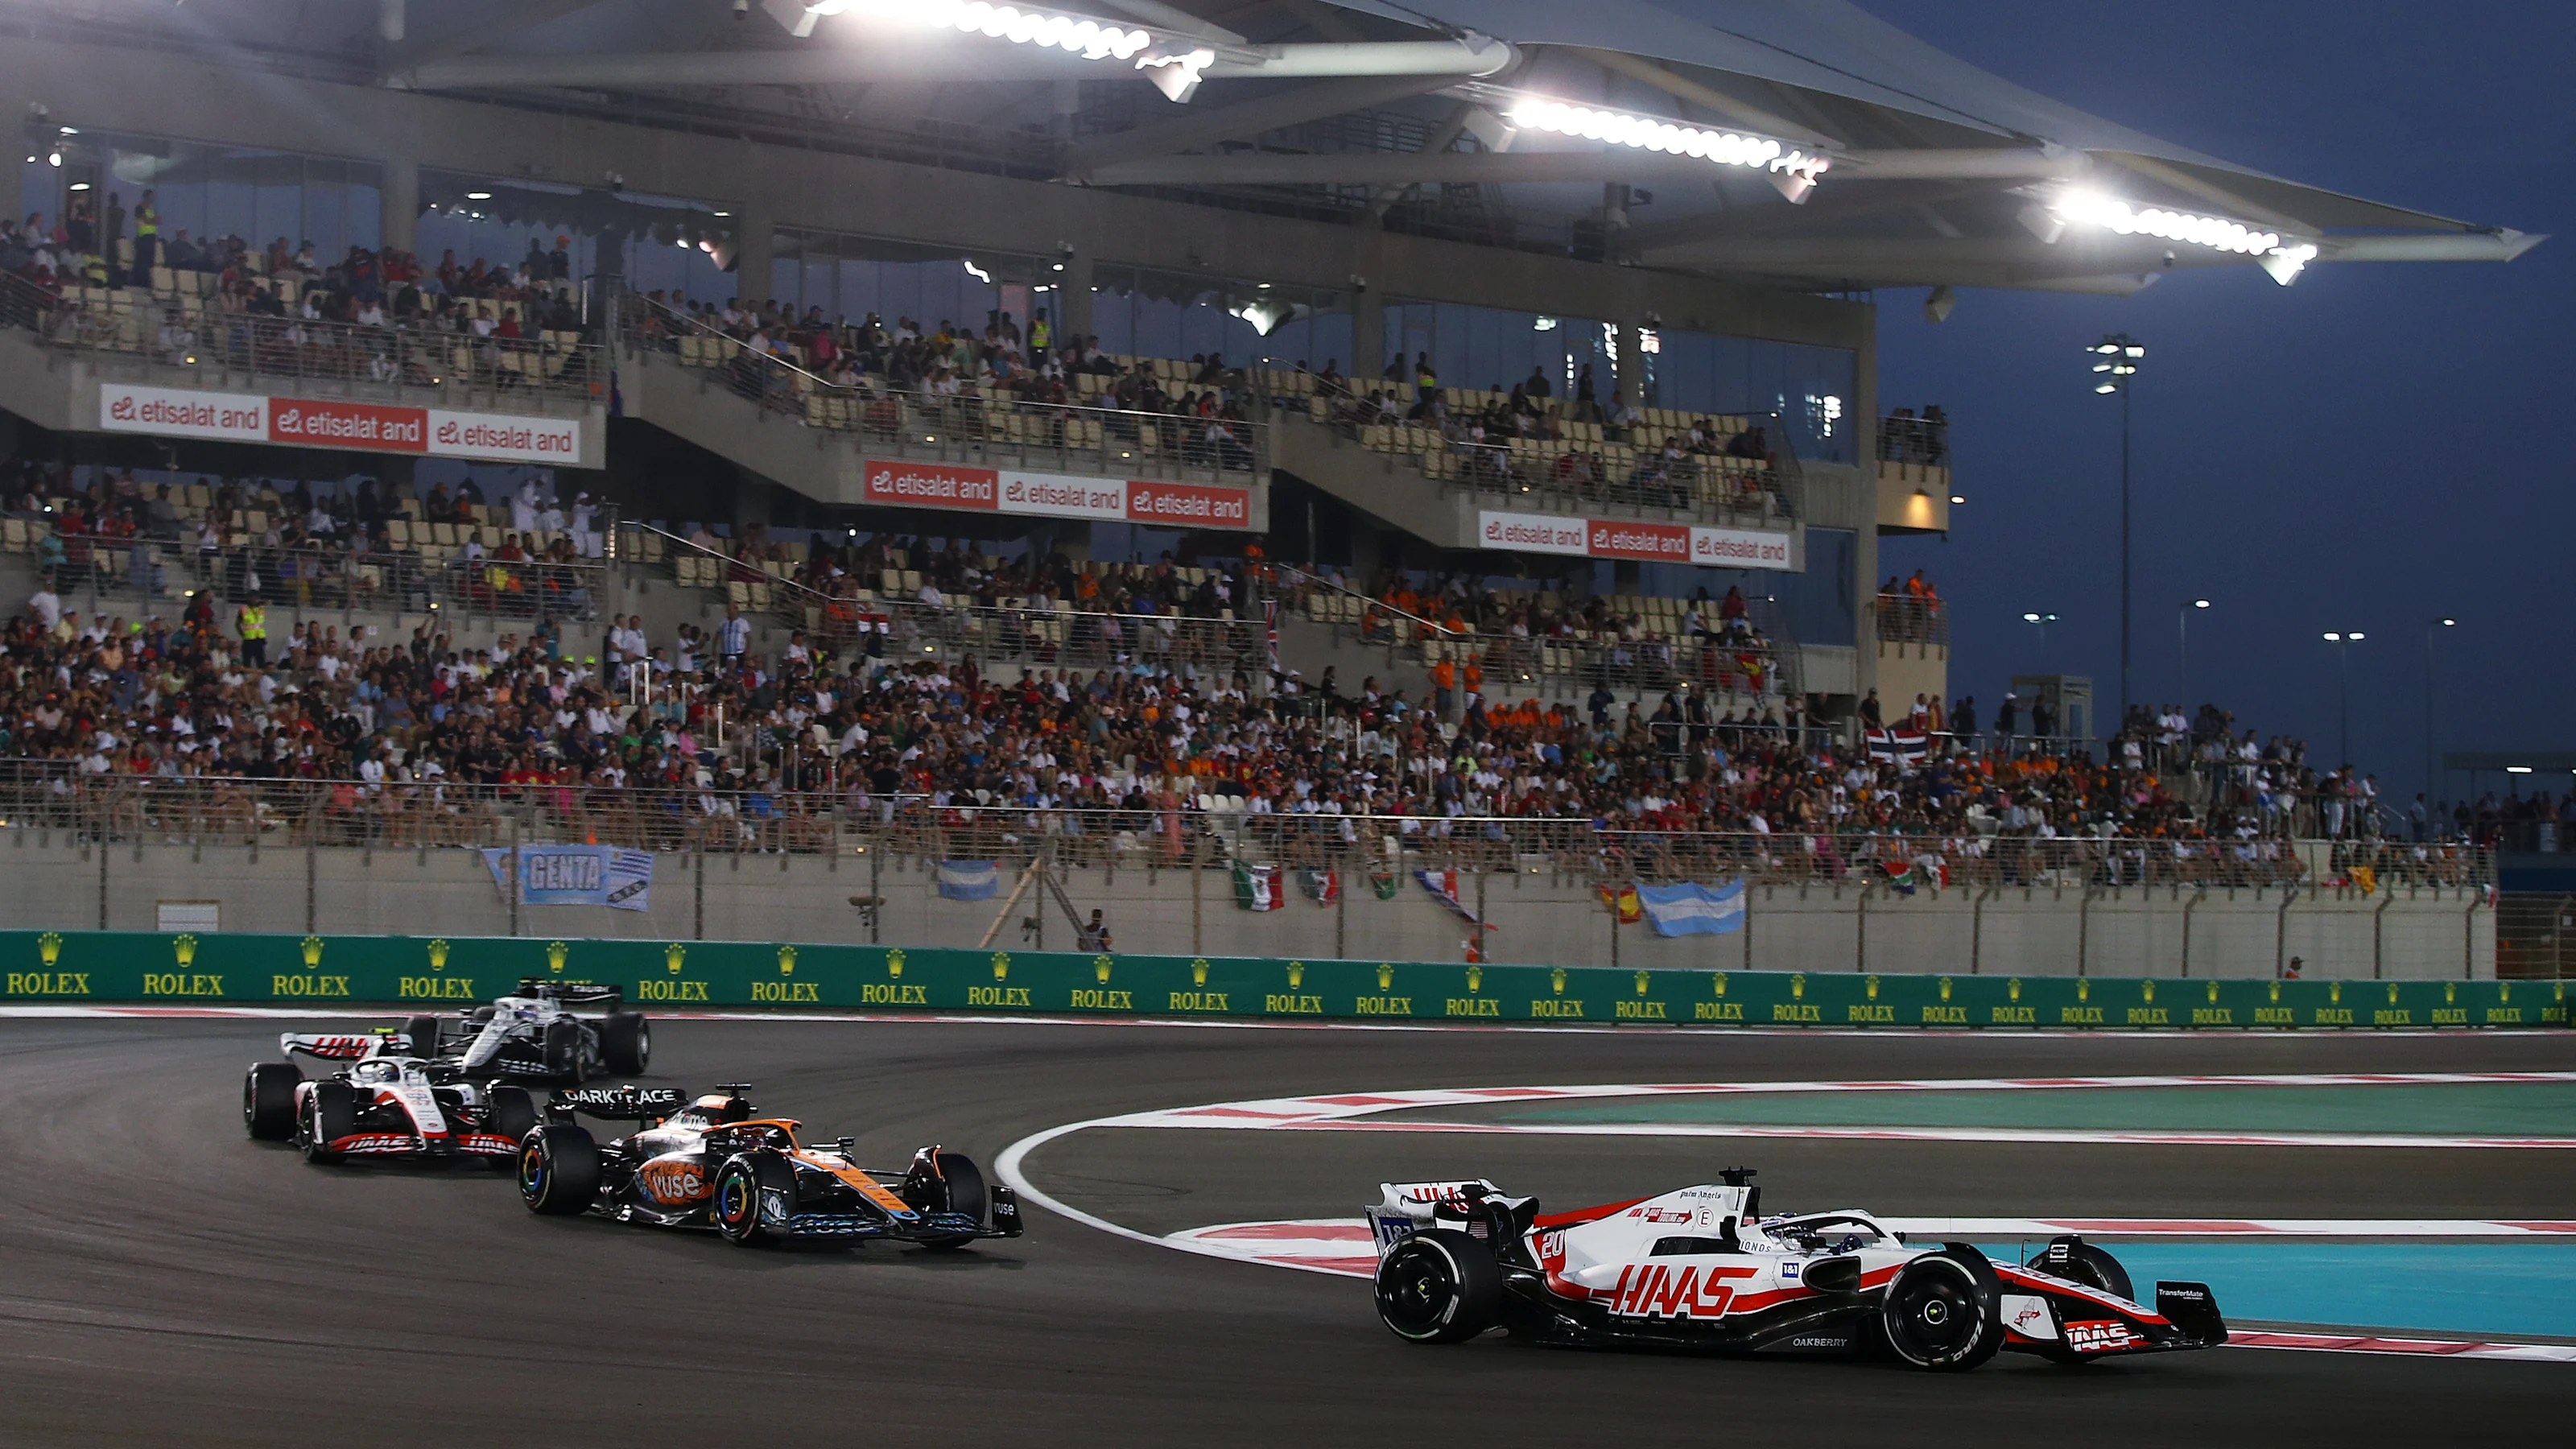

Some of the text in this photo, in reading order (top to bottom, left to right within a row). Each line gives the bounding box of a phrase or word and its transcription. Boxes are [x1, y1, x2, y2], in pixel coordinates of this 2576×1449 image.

[141, 399, 216, 427] etisalat
[221, 407, 259, 429] and
[307, 411, 378, 439] etisalat
[382, 419, 420, 442] and
[464, 424, 533, 449] etisalat
[537, 431, 572, 452] and
[896, 473, 956, 497] etisalat
[960, 479, 992, 500] and
[1030, 484, 1086, 507] etisalat
[1090, 489, 1120, 510] and
[1155, 493, 1211, 516] etisalat
[1214, 497, 1243, 518] and
[1505, 524, 1554, 545] etisalat
[1557, 528, 1581, 547] and
[1612, 530, 1658, 552] etisalat
[1661, 535, 1686, 553] and
[1714, 539, 1758, 559] etisalat
[1761, 543, 1785, 560] and
[530, 854, 601, 890] GENTA
[8, 973, 90, 995] ROLEX
[143, 974, 224, 996] ROLEX
[272, 976, 349, 997] ROLEX
[399, 977, 473, 999] ROLEX
[638, 980, 708, 1001] ROLEX
[752, 982, 819, 1002] ROLEX
[862, 984, 927, 1005] ROLEX
[968, 987, 1030, 1006] ROLEX
[1071, 989, 1133, 1009] ROLEX
[1169, 992, 1228, 1011] ROLEX
[1265, 994, 1322, 1013] ROLEX
[1356, 997, 1412, 1015] ROLEX
[1446, 999, 1499, 1016] ROLEX
[1532, 1000, 1583, 1018] ROLEX
[1616, 1001, 1666, 1019] ROLEX
[1695, 1003, 1743, 1020] ROLEX
[1773, 1005, 1821, 1022] ROLEX
[1850, 1005, 1894, 1022] ROLEX
[1922, 1007, 1967, 1022] ROLEX
[1992, 1007, 2035, 1022] ROLEX
[2062, 1008, 2103, 1022] ROLEX
[2128, 1008, 2168, 1023] ROLEX
[2255, 1008, 2293, 1022] ROLEX
[2487, 1008, 2521, 1022] ROLEX
[2193, 1009, 2231, 1023] ROLEX
[2316, 1009, 2353, 1024] ROLEX
[2375, 1009, 2410, 1024] ROLEX
[2432, 1009, 2467, 1023] ROLEX
[653, 1174, 700, 1198] vuse
[1542, 1229, 1564, 1258] 20
[1740, 1241, 1772, 1253] IONOS
[1782, 1265, 1798, 1274] 1&1
[1608, 1264, 1760, 1319] HAAS
[2158, 1289, 2203, 1297] TransferMate
[1793, 1338, 1848, 1347] OAKBERRY
